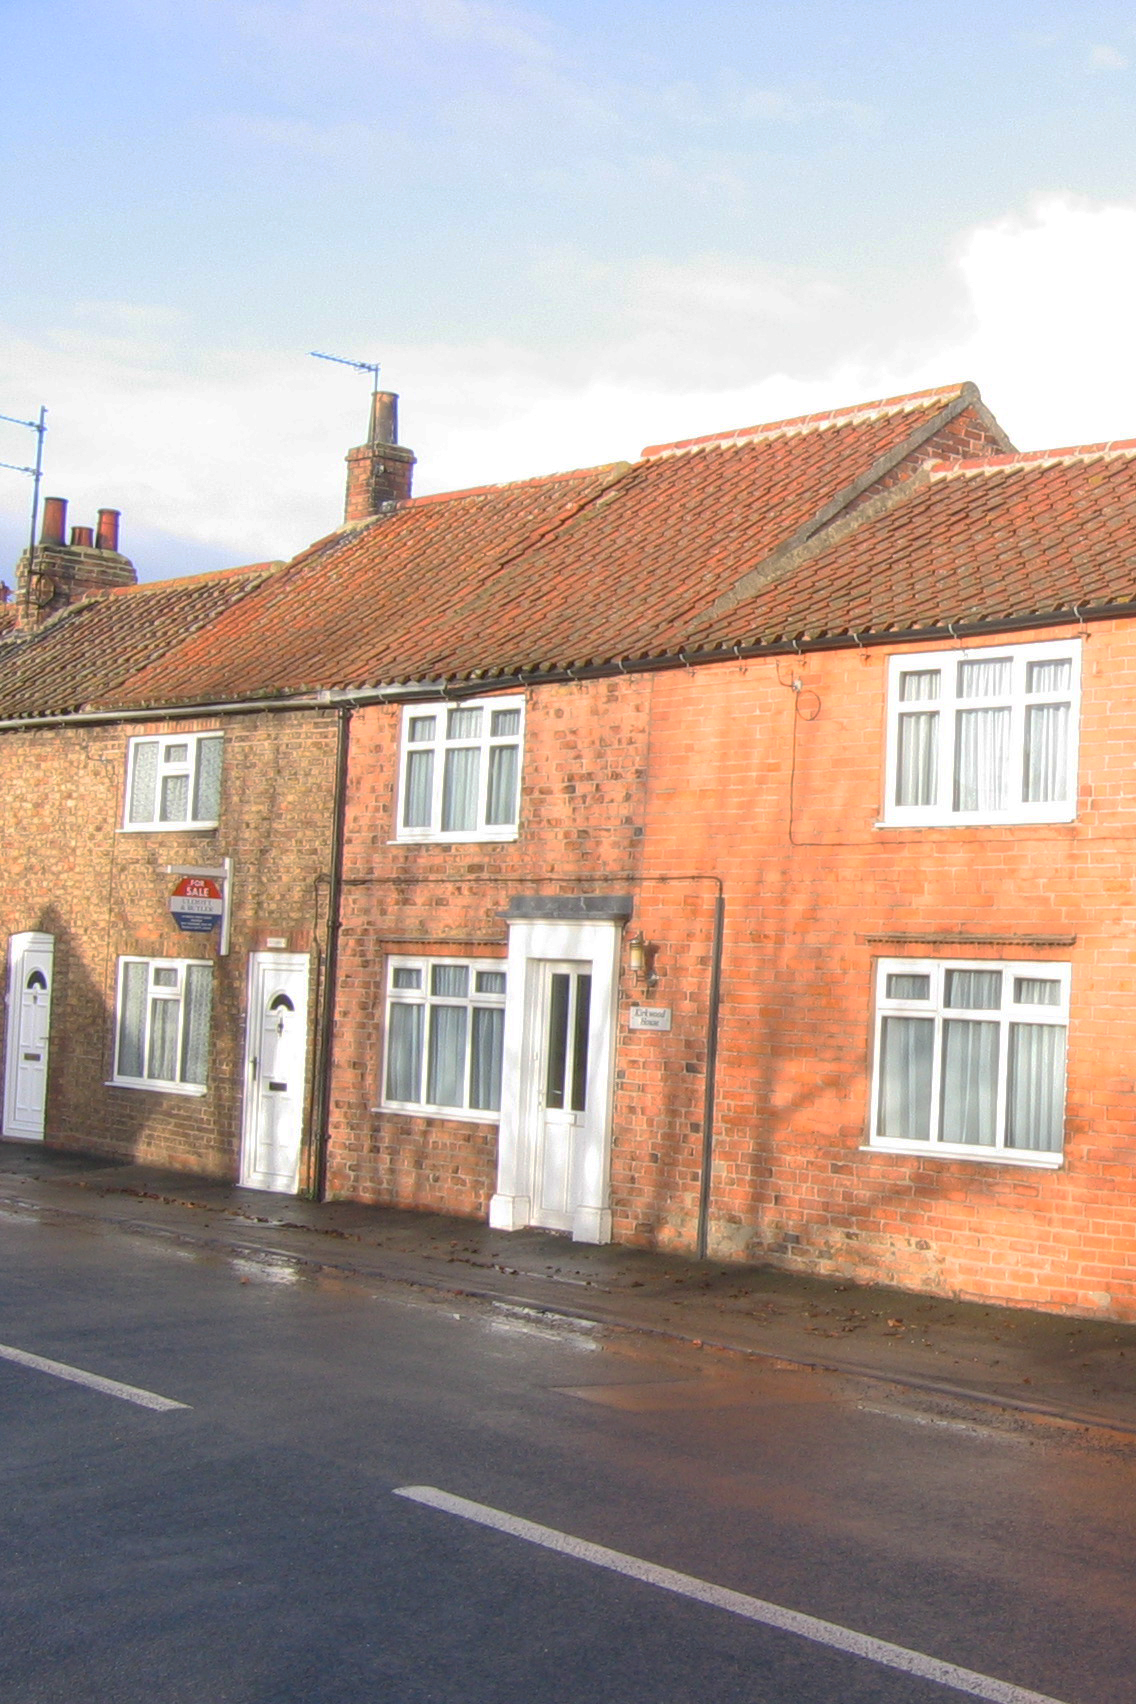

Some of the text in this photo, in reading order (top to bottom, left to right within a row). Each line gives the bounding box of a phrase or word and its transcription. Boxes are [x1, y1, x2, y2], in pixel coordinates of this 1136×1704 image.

[190, 879, 206, 888] FOR
[186, 886, 210, 898] SALE
[634, 1008, 667, 1018] Kirkwood
